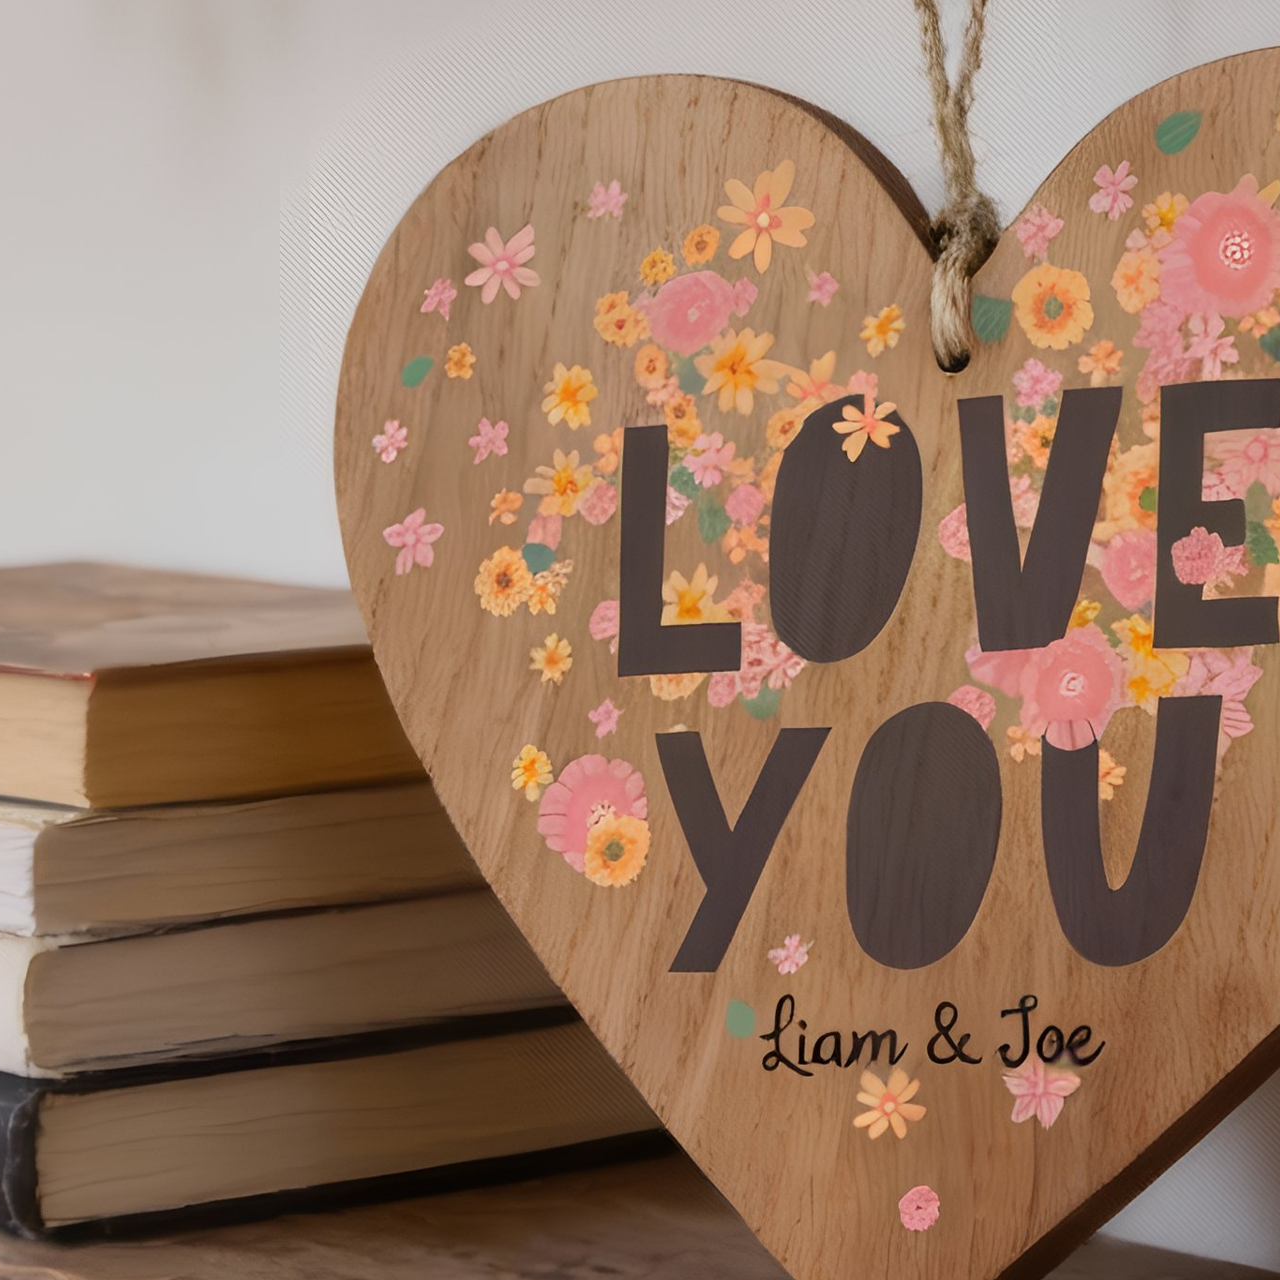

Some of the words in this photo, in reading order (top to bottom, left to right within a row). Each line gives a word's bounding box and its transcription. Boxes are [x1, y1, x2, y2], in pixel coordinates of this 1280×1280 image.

[654, 694, 1223, 973] YOU
[760, 994, 908, 1077] Liam
[926, 1000, 982, 1067] &
[994, 994, 1106, 1068] Joe
